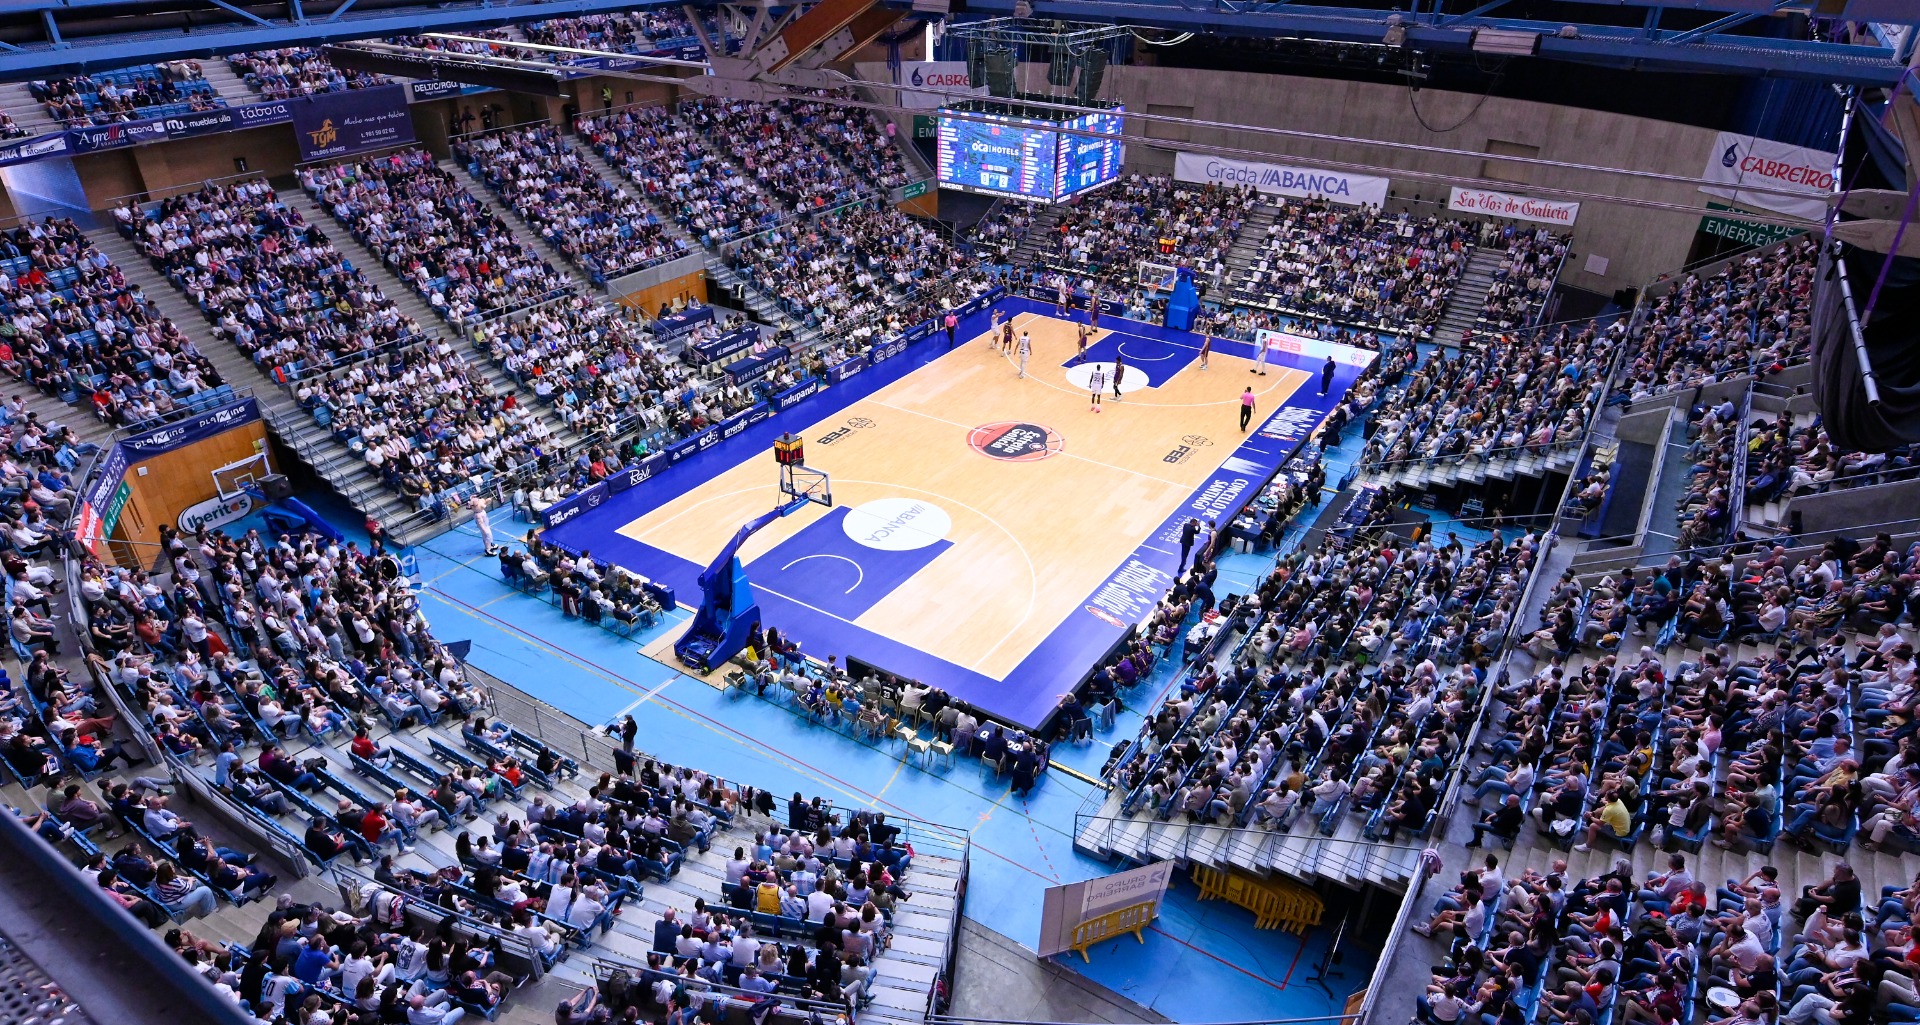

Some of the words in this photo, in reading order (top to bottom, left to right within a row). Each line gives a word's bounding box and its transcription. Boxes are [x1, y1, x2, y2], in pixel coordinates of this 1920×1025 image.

[189, 116, 218, 128] muebles
[344, 117, 363, 126] Mucho
[376, 115, 387, 123] que
[388, 111, 405, 119] toldos
[991, 147, 1020, 156] HOTELS
[1206, 161, 1257, 184] Grada
[1453, 191, 1475, 208] La
[1505, 197, 1519, 213] de
[1522, 200, 1569, 220] Galicia
[1269, 338, 1301, 352] FEB
[781, 382, 817, 408] indupanel
[817, 427, 851, 445] FEB
[1163, 445, 1191, 463] FEB
[1191, 479, 1229, 510] SANTIAGO
[1212, 478, 1249, 510] CONCELLO
[187, 499, 248, 529] Iberitos
[1202, 510, 1222, 520] DE
[1113, 559, 1174, 595] Estrella
[1091, 582, 1152, 618] Galicia
[1145, 645, 1152, 653] 8
[806, 693, 812, 701] 8
